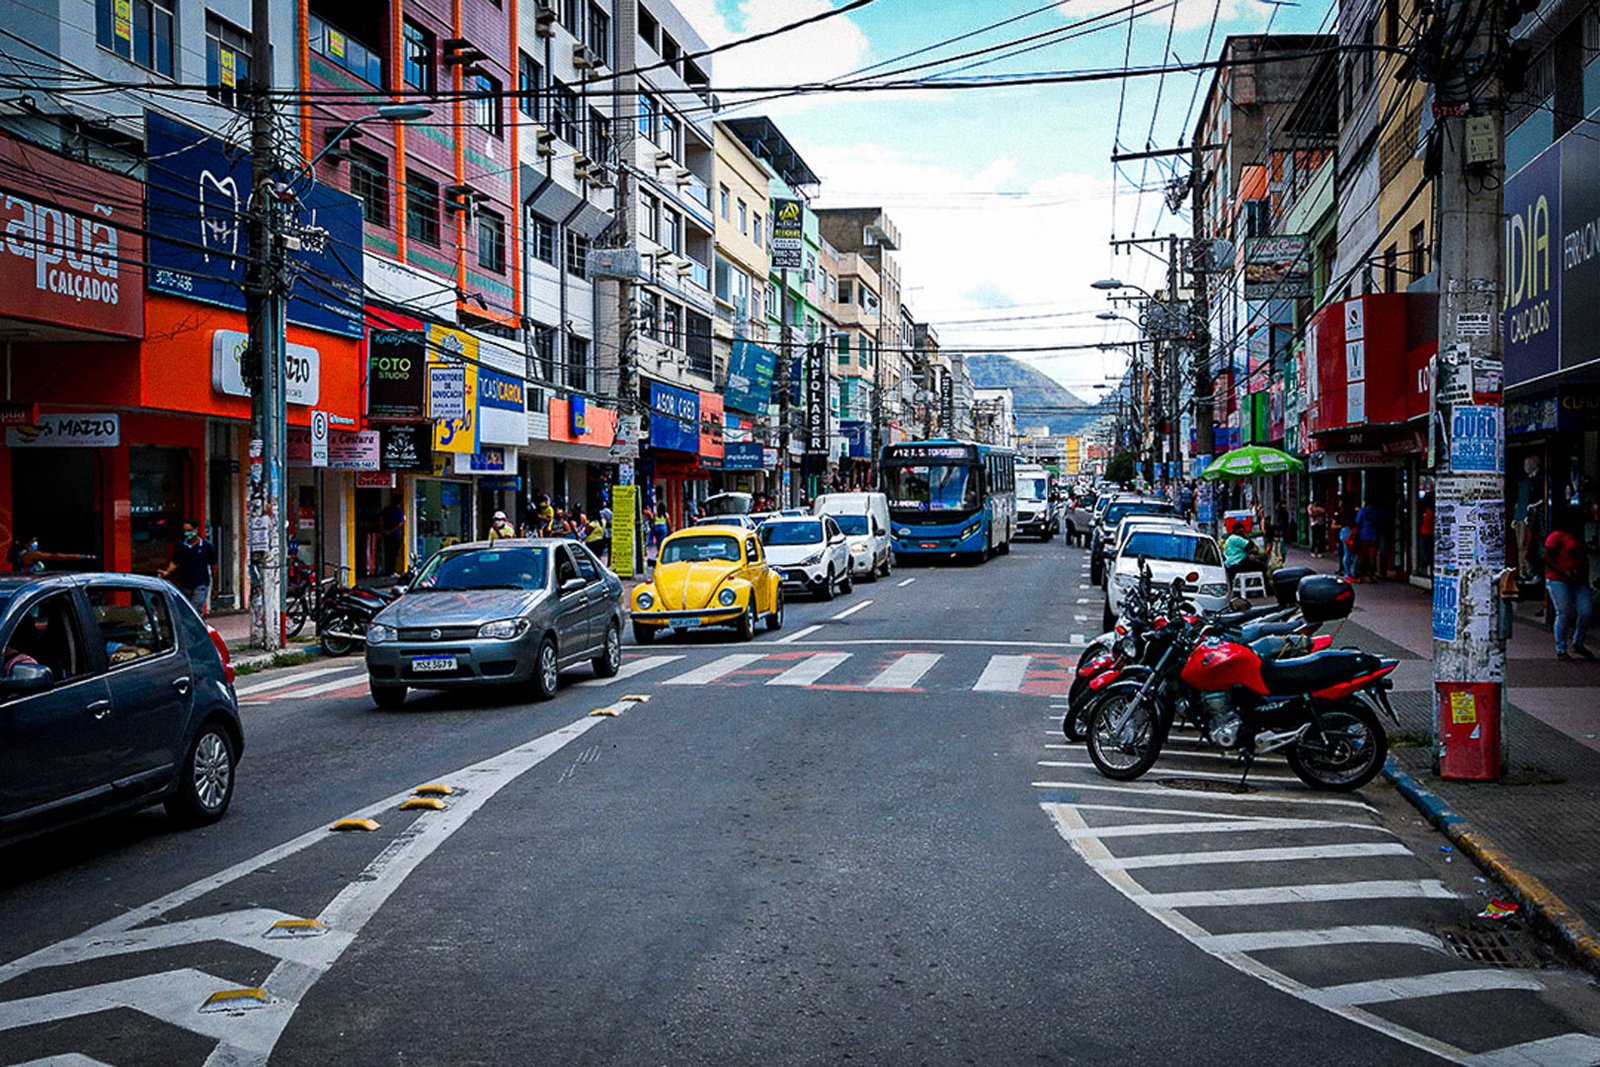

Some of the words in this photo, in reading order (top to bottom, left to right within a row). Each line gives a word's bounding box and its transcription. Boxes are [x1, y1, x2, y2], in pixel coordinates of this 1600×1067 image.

[0, 192, 118, 289] apuã
[49, 269, 118, 305] CALÇADOS
[1511, 300, 1550, 345] CALÇADOS
[286, 355, 310, 383] ZZO
[371, 357, 412, 372] FOTO
[378, 371, 410, 380] STUDIO
[498, 380, 523, 404] CAROL
[810, 346, 823, 449] INFOLASER
[57, 419, 115, 437] MAZZO
[1453, 416, 1496, 438] OURO
